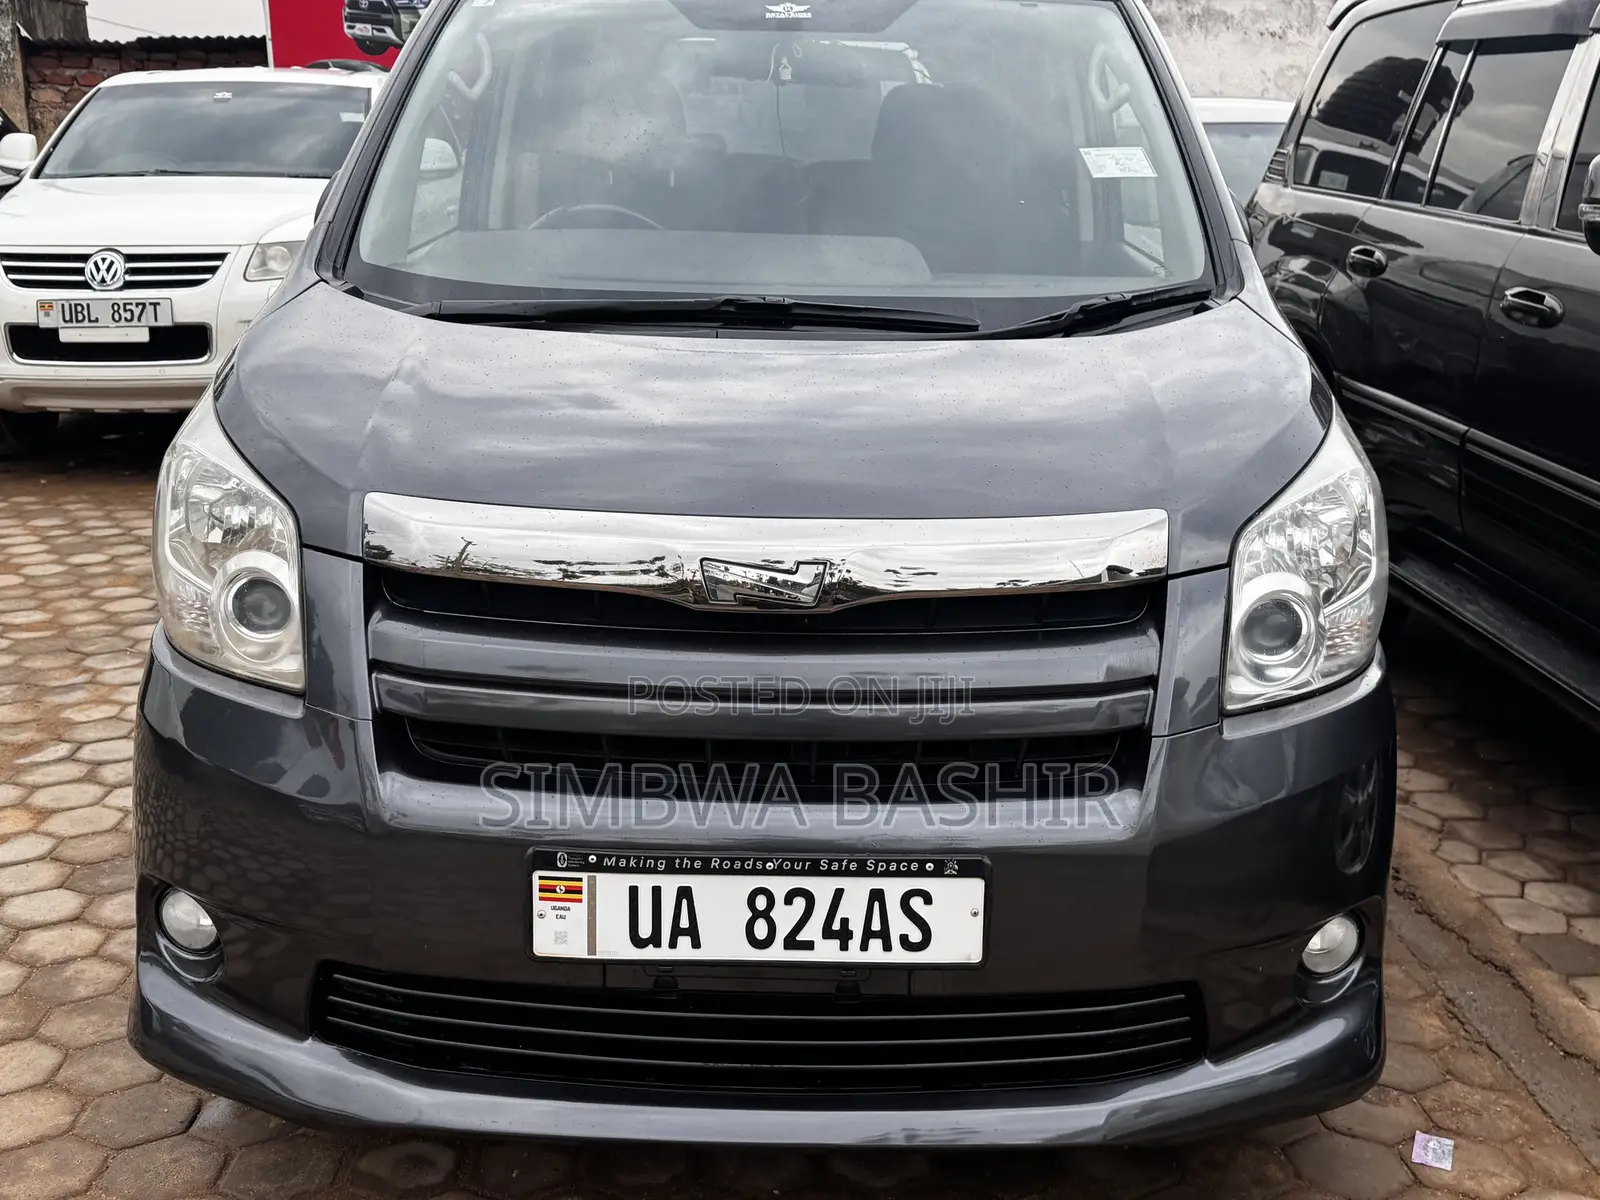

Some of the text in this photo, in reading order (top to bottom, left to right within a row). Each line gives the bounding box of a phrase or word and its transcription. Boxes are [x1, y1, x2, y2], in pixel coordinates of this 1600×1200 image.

[61, 302, 161, 323] UBL 857T
[603, 856, 919, 873] Making the Roads Your Safe Space
[628, 885, 934, 952] UA 824AS
